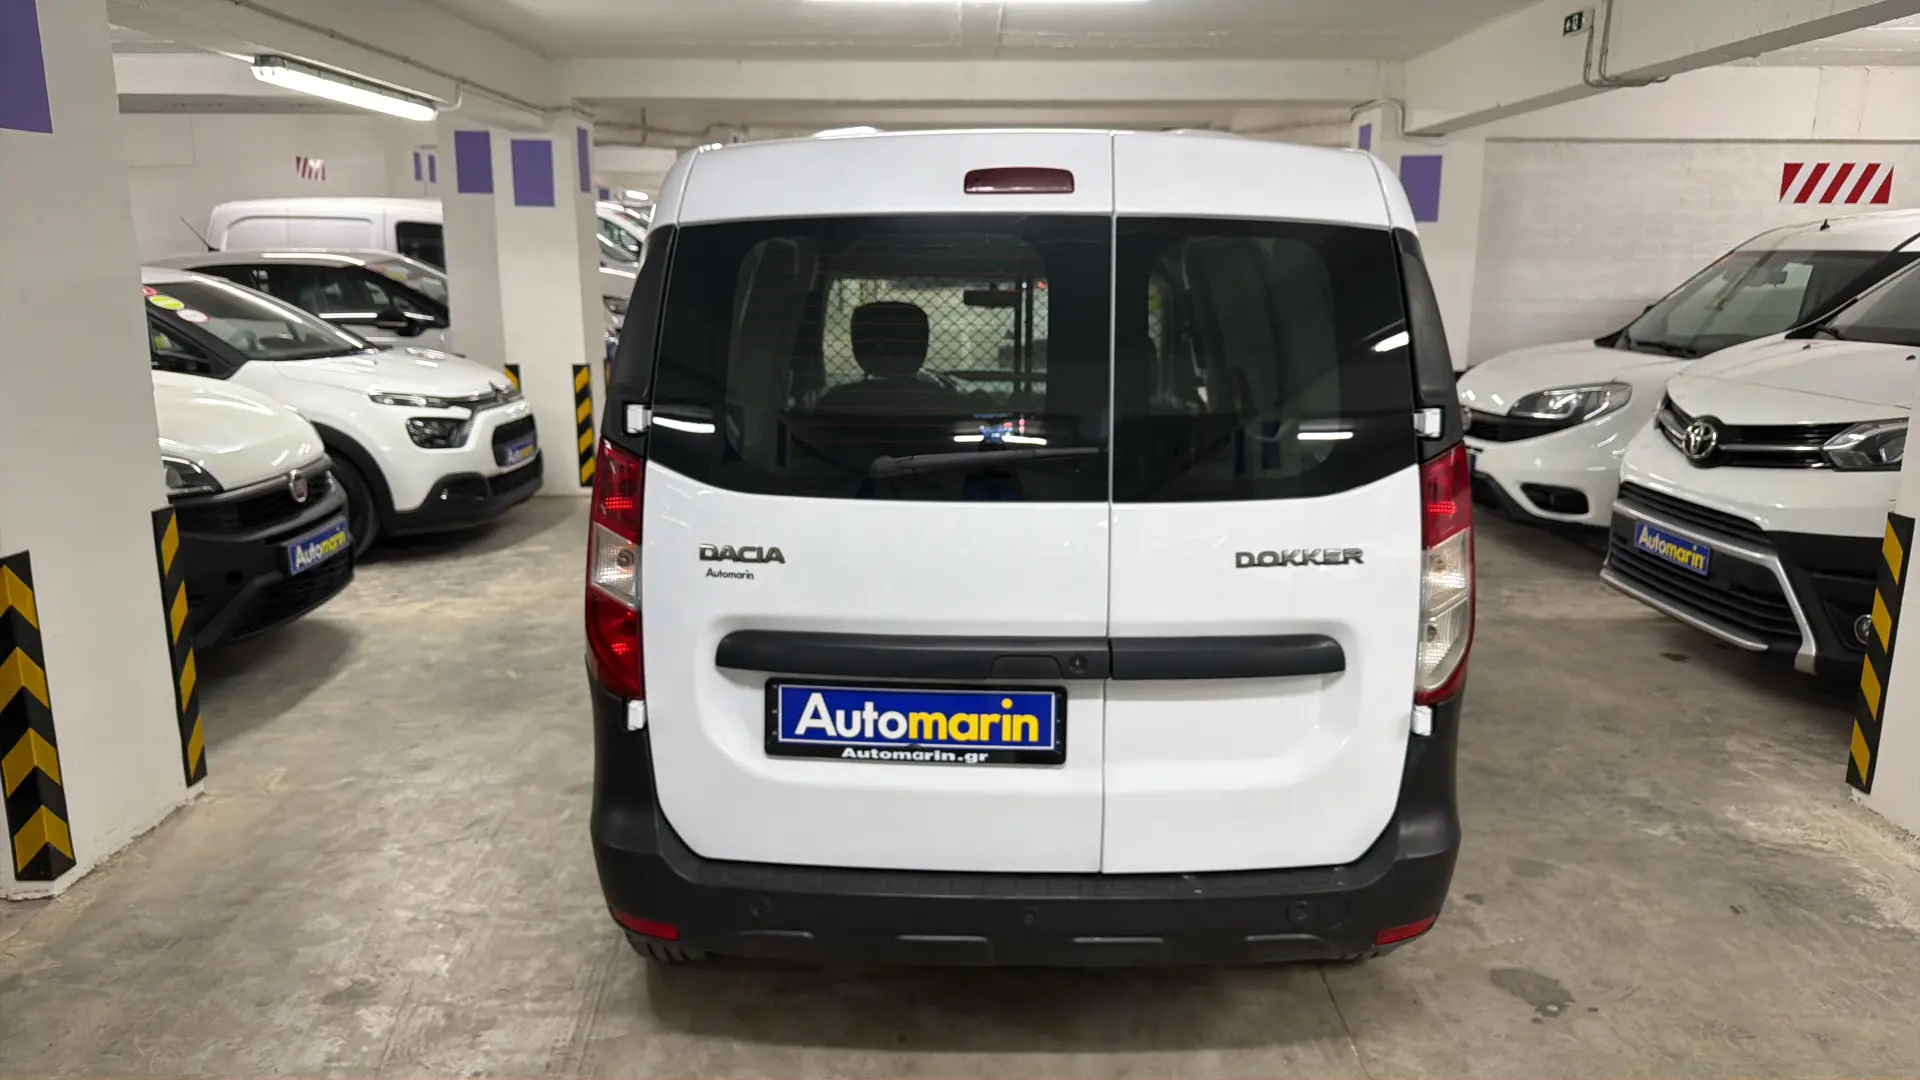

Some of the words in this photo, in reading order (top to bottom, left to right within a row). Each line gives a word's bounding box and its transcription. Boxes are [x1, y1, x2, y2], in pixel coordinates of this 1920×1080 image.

[699, 543, 785, 564] DACIA
[1638, 525, 1704, 569] Automarin
[1235, 547, 1364, 569] DOKKER
[705, 567, 755, 580] Automarin
[794, 692, 1039, 742] Automarin
[841, 747, 989, 764] Automarin.gr
